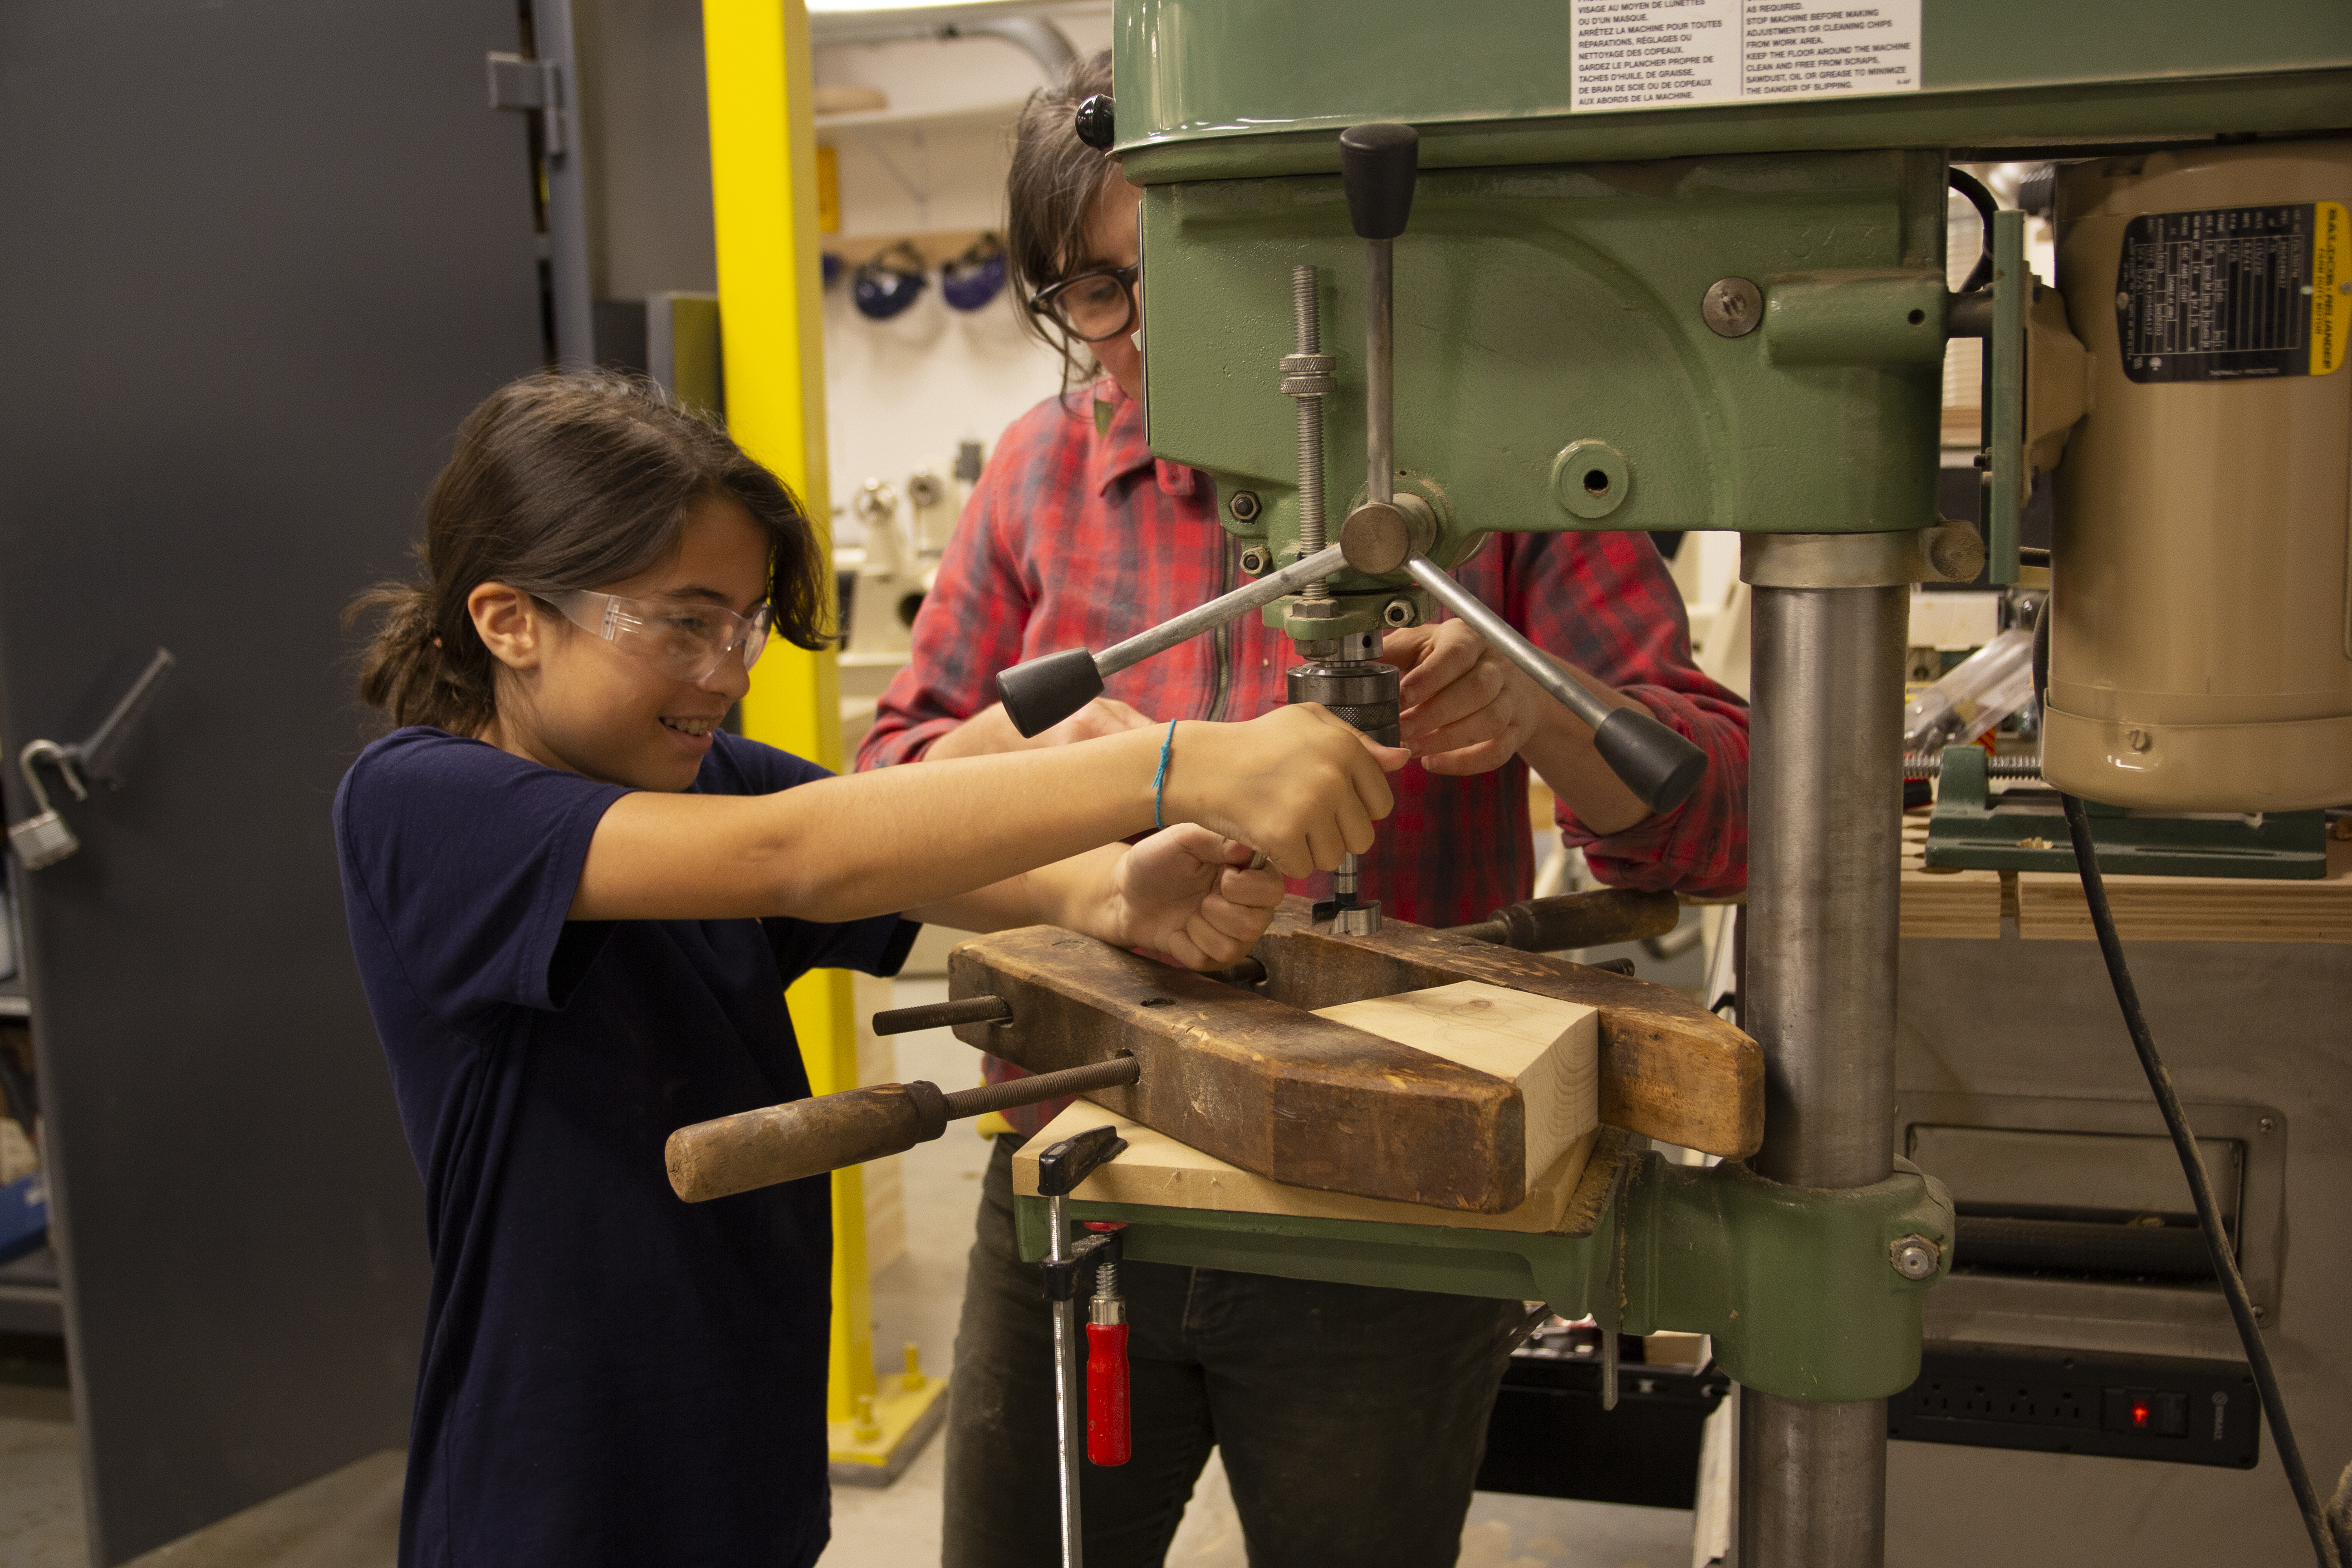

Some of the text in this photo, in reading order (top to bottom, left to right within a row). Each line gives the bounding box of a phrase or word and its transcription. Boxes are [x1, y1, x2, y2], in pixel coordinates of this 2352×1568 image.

[1578, 5, 1606, 14] VISAGE
[1621, 2, 1650, 10] MOYEN
[1770, 15, 1808, 23] MACHINE
[1810, 11, 1843, 20] BEFORE
[1845, 10, 1879, 18] MAKING
[1578, 27, 1614, 37] ARRÊTEZ
[1627, 24, 1664, 34] MACHINE
[1666, 23, 1688, 31] POUR
[1691, 20, 1722, 29] TOUTES
[1746, 26, 1807, 36] ADJUSTMENTS
[1823, 22, 1865, 32] CLEANING
[1866, 20, 1892, 28] CHIPS
[1636, 34, 1678, 44] RÉGLAGES
[1680, 34, 1692, 42] OU
[1746, 40, 1770, 49] FROM
[1772, 38, 1797, 46] WORK
[1579, 50, 1624, 59] NETTOYAGE
[1787, 49, 1815, 57] FLOOR
[1817, 47, 1852, 55] AROUND
[1872, 43, 1911, 51] MACHINE
[1579, 63, 1610, 71] GARDEZ
[1624, 59, 1666, 69] PLANCHER
[1668, 57, 1700, 65] PROPRE
[1746, 64, 1773, 72] CLEAN
[1795, 60, 1816, 69] FREE
[1819, 70, 1852, 78] GREASE
[1867, 66, 1906, 75] MINIMIZE
[1579, 74, 1609, 83] TACHES
[1674, 79, 1712, 88] COPEAUX
[1764, 84, 1798, 93] DANGER
[1597, 96, 1629, 104] ABORDS
